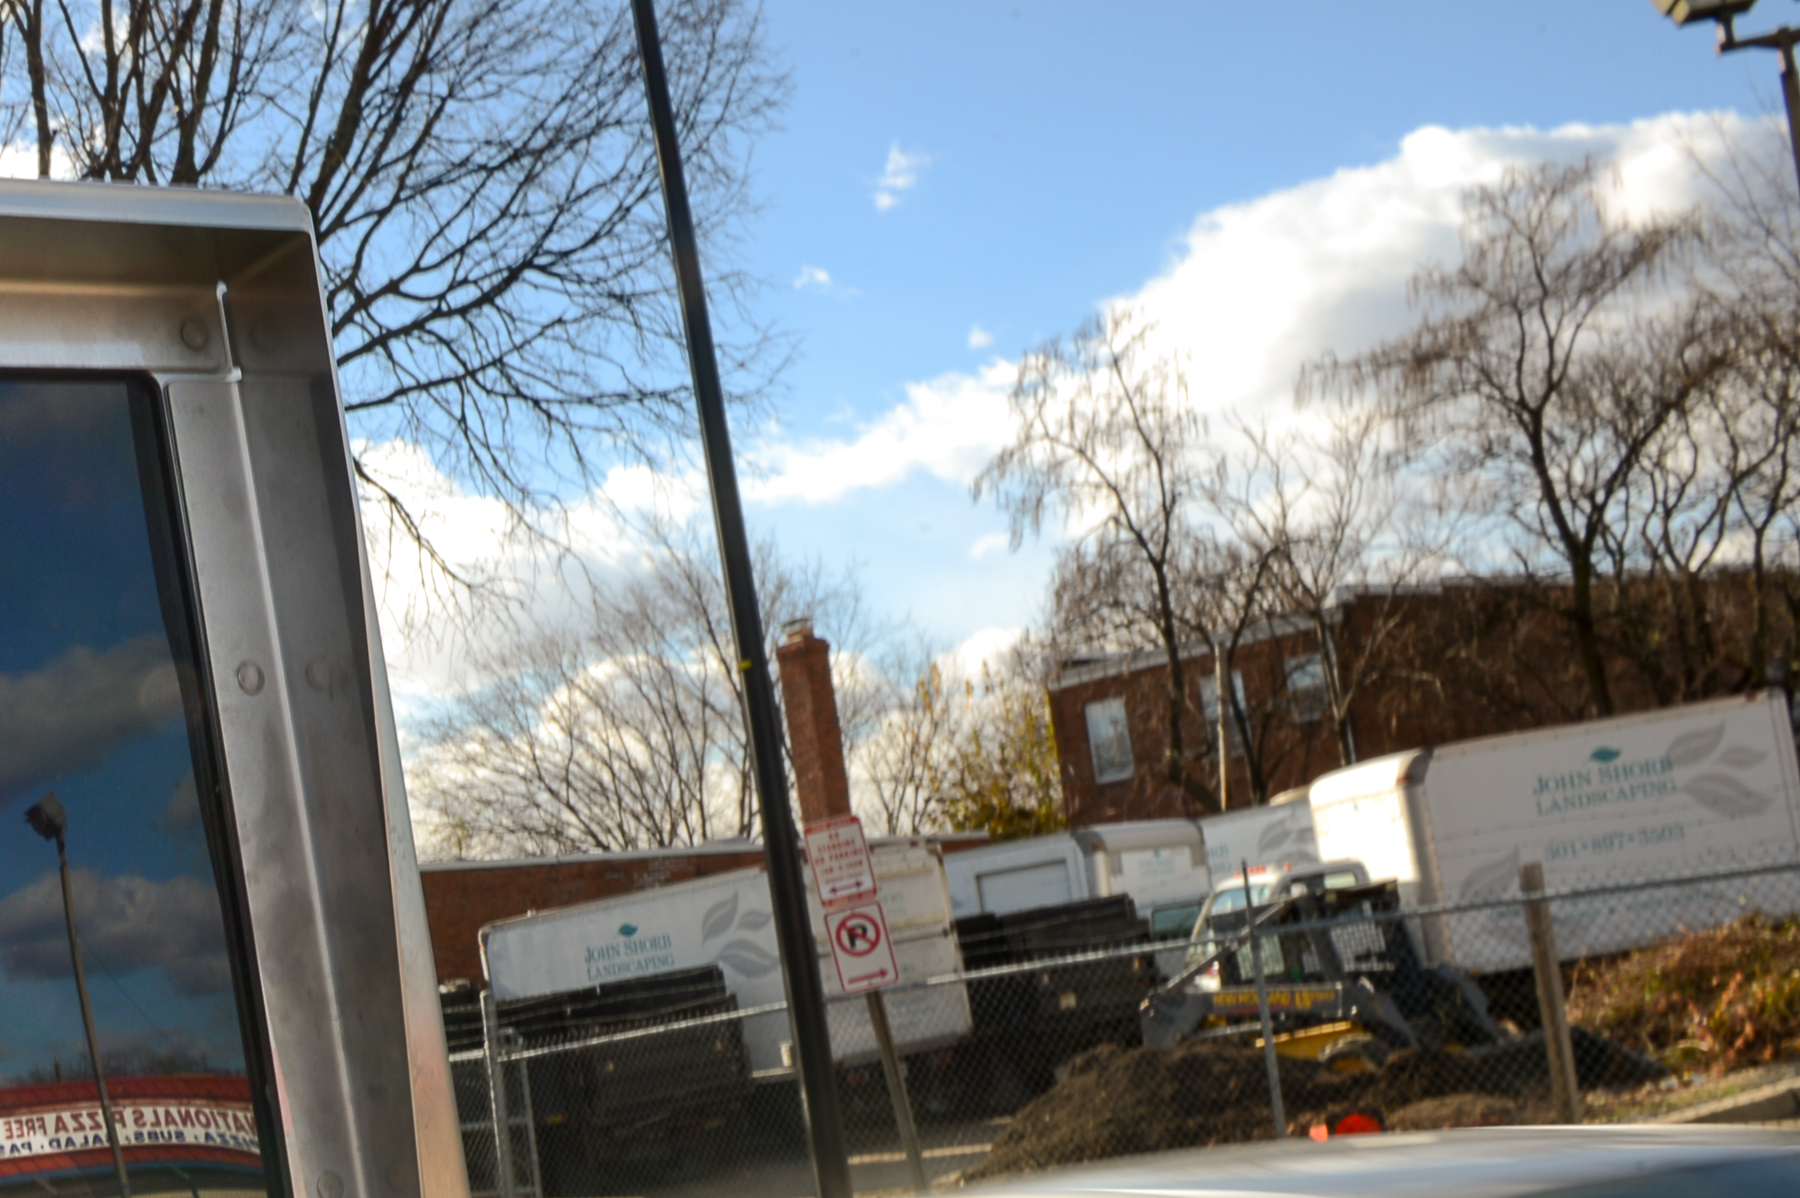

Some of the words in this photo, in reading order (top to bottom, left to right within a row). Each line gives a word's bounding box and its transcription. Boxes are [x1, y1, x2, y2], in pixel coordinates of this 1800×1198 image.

[1533, 771, 1592, 797] JOHN
[1537, 778, 1678, 817] LANDSCAPING
[584, 945, 622, 965] JOHN
[625, 933, 673, 955] SHORB
[587, 952, 675, 982] LANDSCAPING
